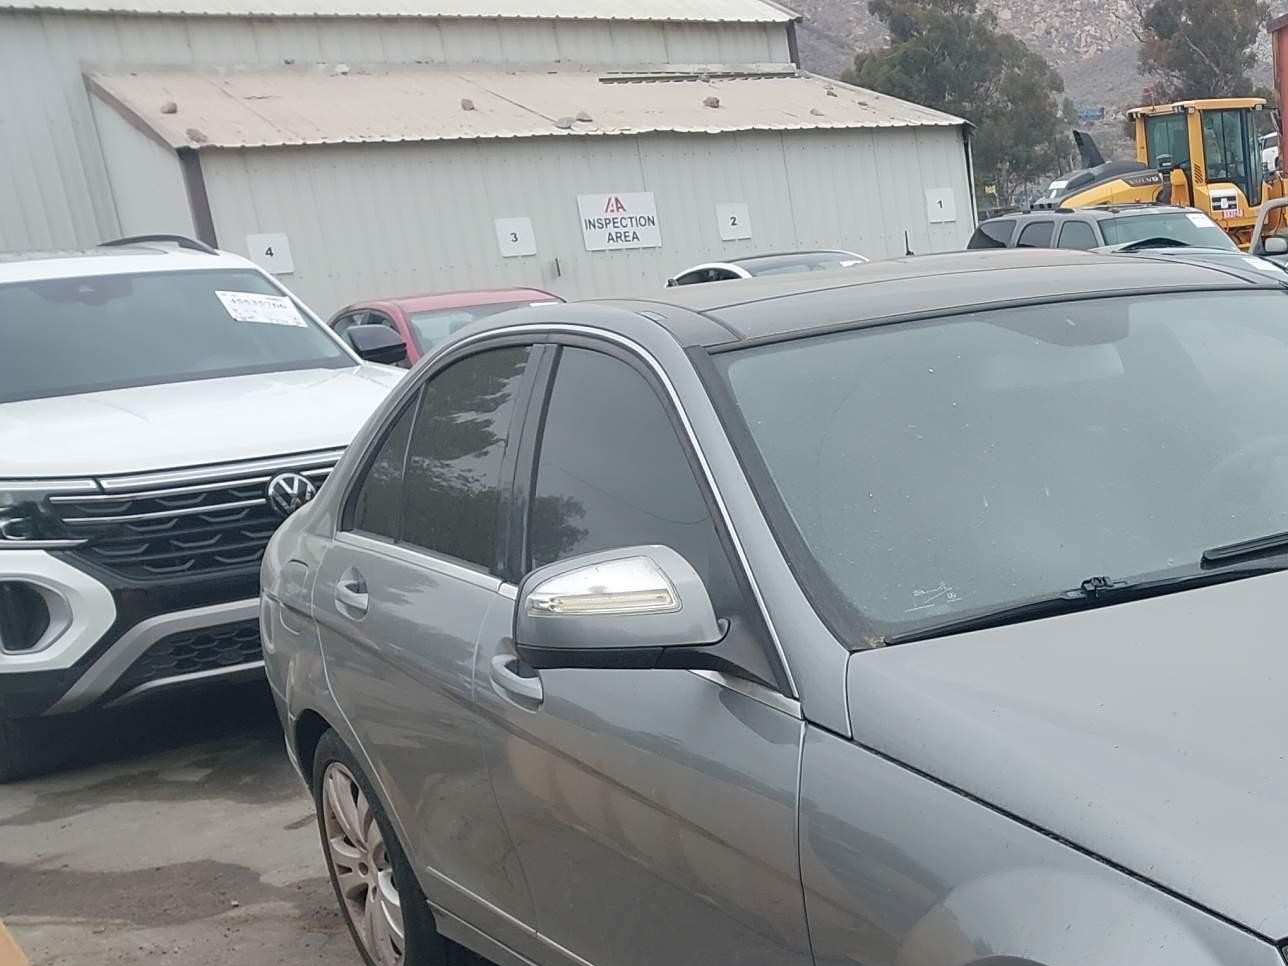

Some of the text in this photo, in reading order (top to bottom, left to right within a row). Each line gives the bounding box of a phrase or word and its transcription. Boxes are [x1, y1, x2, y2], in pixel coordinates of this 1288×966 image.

[937, 200, 943, 209] 1
[584, 215, 655, 230] INSPECTION
[729, 216, 737, 226] 2
[510, 232, 519, 243] 3
[607, 231, 640, 243] AREA
[265, 246, 274, 257] 4
